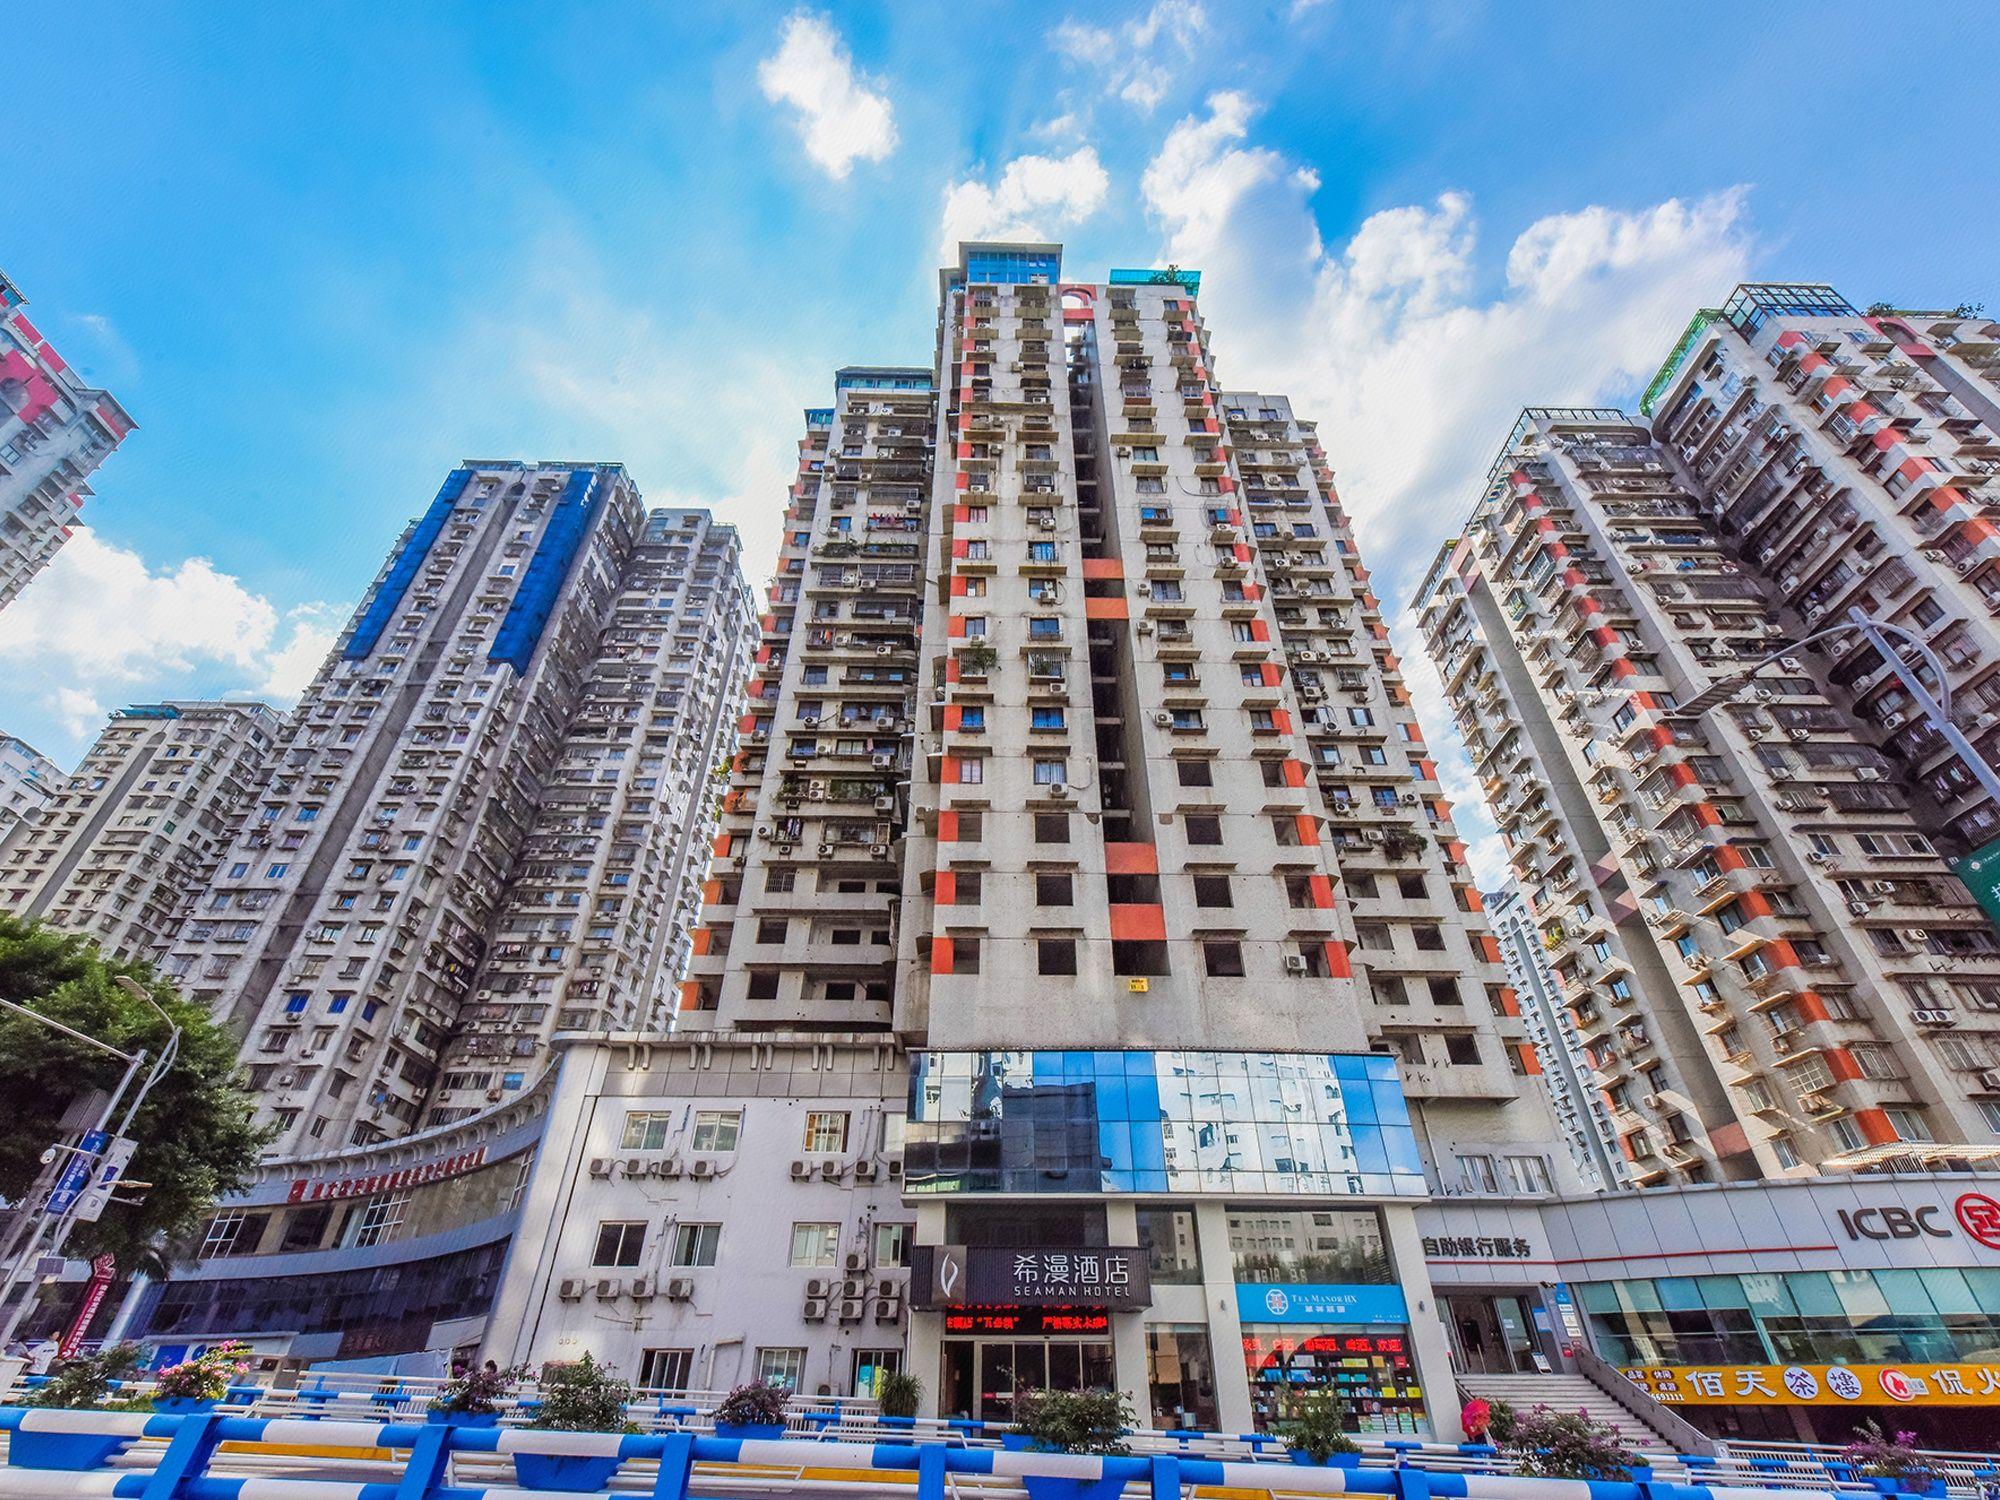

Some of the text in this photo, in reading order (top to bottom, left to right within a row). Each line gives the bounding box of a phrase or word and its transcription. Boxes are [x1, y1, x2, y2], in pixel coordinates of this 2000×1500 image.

[1837, 1206, 1953, 1241] ICBC
[1422, 1237, 1531, 1257] 自助银行服务
[1013, 1254, 1129, 1284] 希漫酒店
[1014, 1286, 1130, 1297] SEAMAN HOTEL
